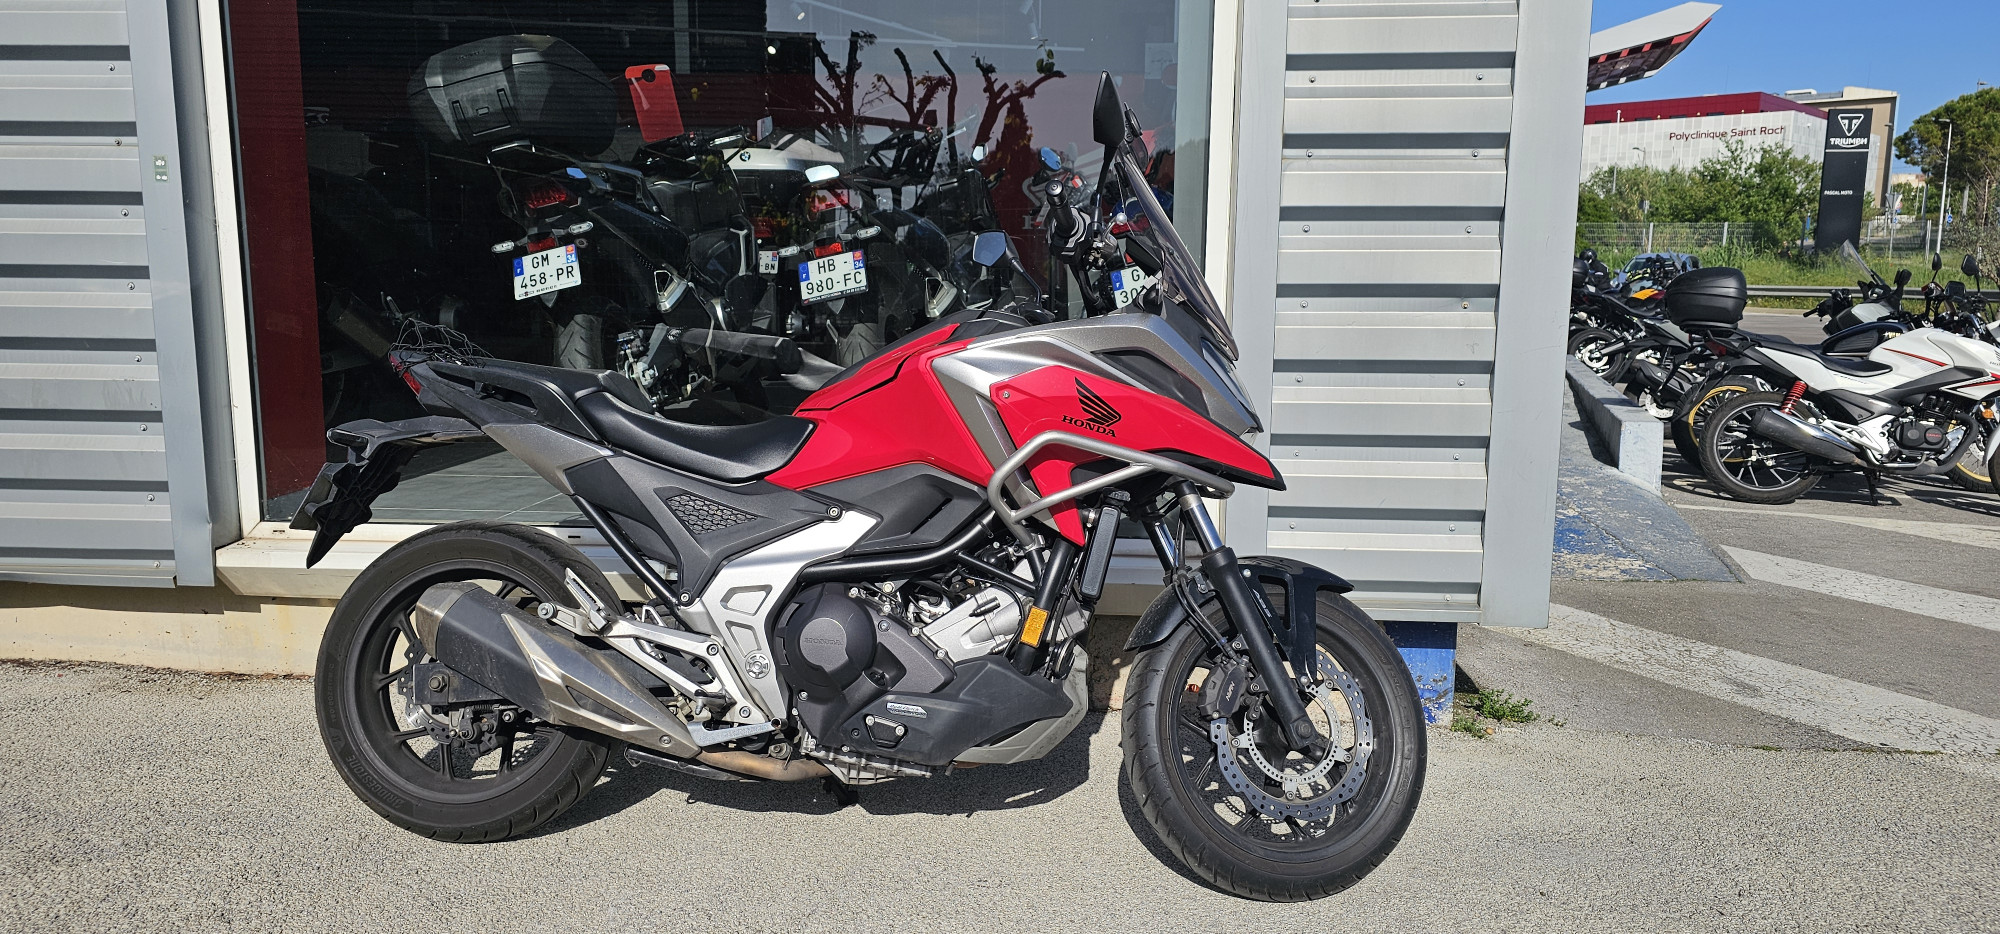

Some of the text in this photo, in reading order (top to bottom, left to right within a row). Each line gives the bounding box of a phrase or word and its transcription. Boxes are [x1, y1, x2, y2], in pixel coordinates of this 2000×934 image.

[1669, 130, 1727, 141] Polyclinique
[1731, 128, 1756, 137] Saint
[567, 254, 576, 263] 34
[854, 260, 864, 269] 34
[520, 265, 575, 290] 458-PR
[806, 271, 863, 295] 980-FC
[1061, 414, 1117, 438] HONDA
[803, 637, 844, 646] HONDA
